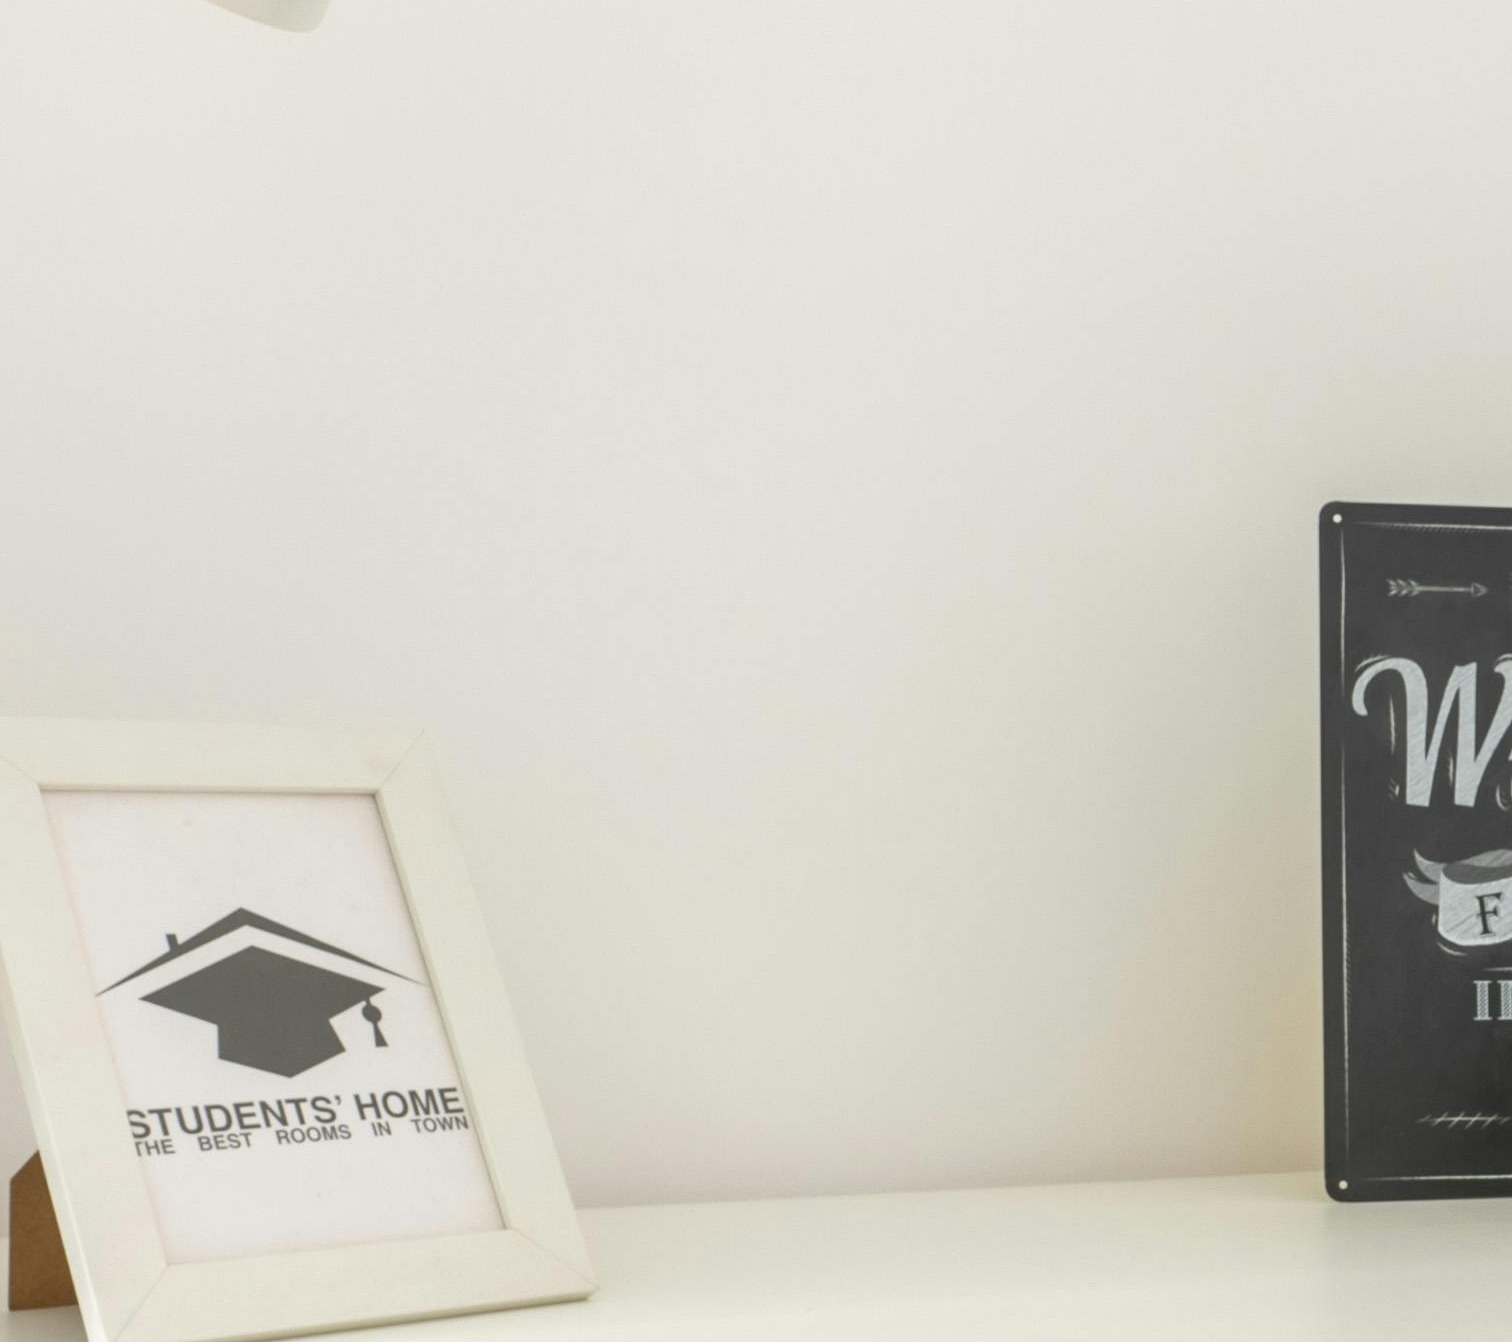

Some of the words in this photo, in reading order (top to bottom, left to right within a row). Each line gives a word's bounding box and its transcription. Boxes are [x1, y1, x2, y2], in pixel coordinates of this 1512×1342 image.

[353, 1087, 464, 1121] HOME
[197, 1132, 252, 1152] BEST
[274, 1124, 352, 1145] ROOMS
[371, 1121, 392, 1137] IN
[410, 1115, 470, 1134] TOWN
